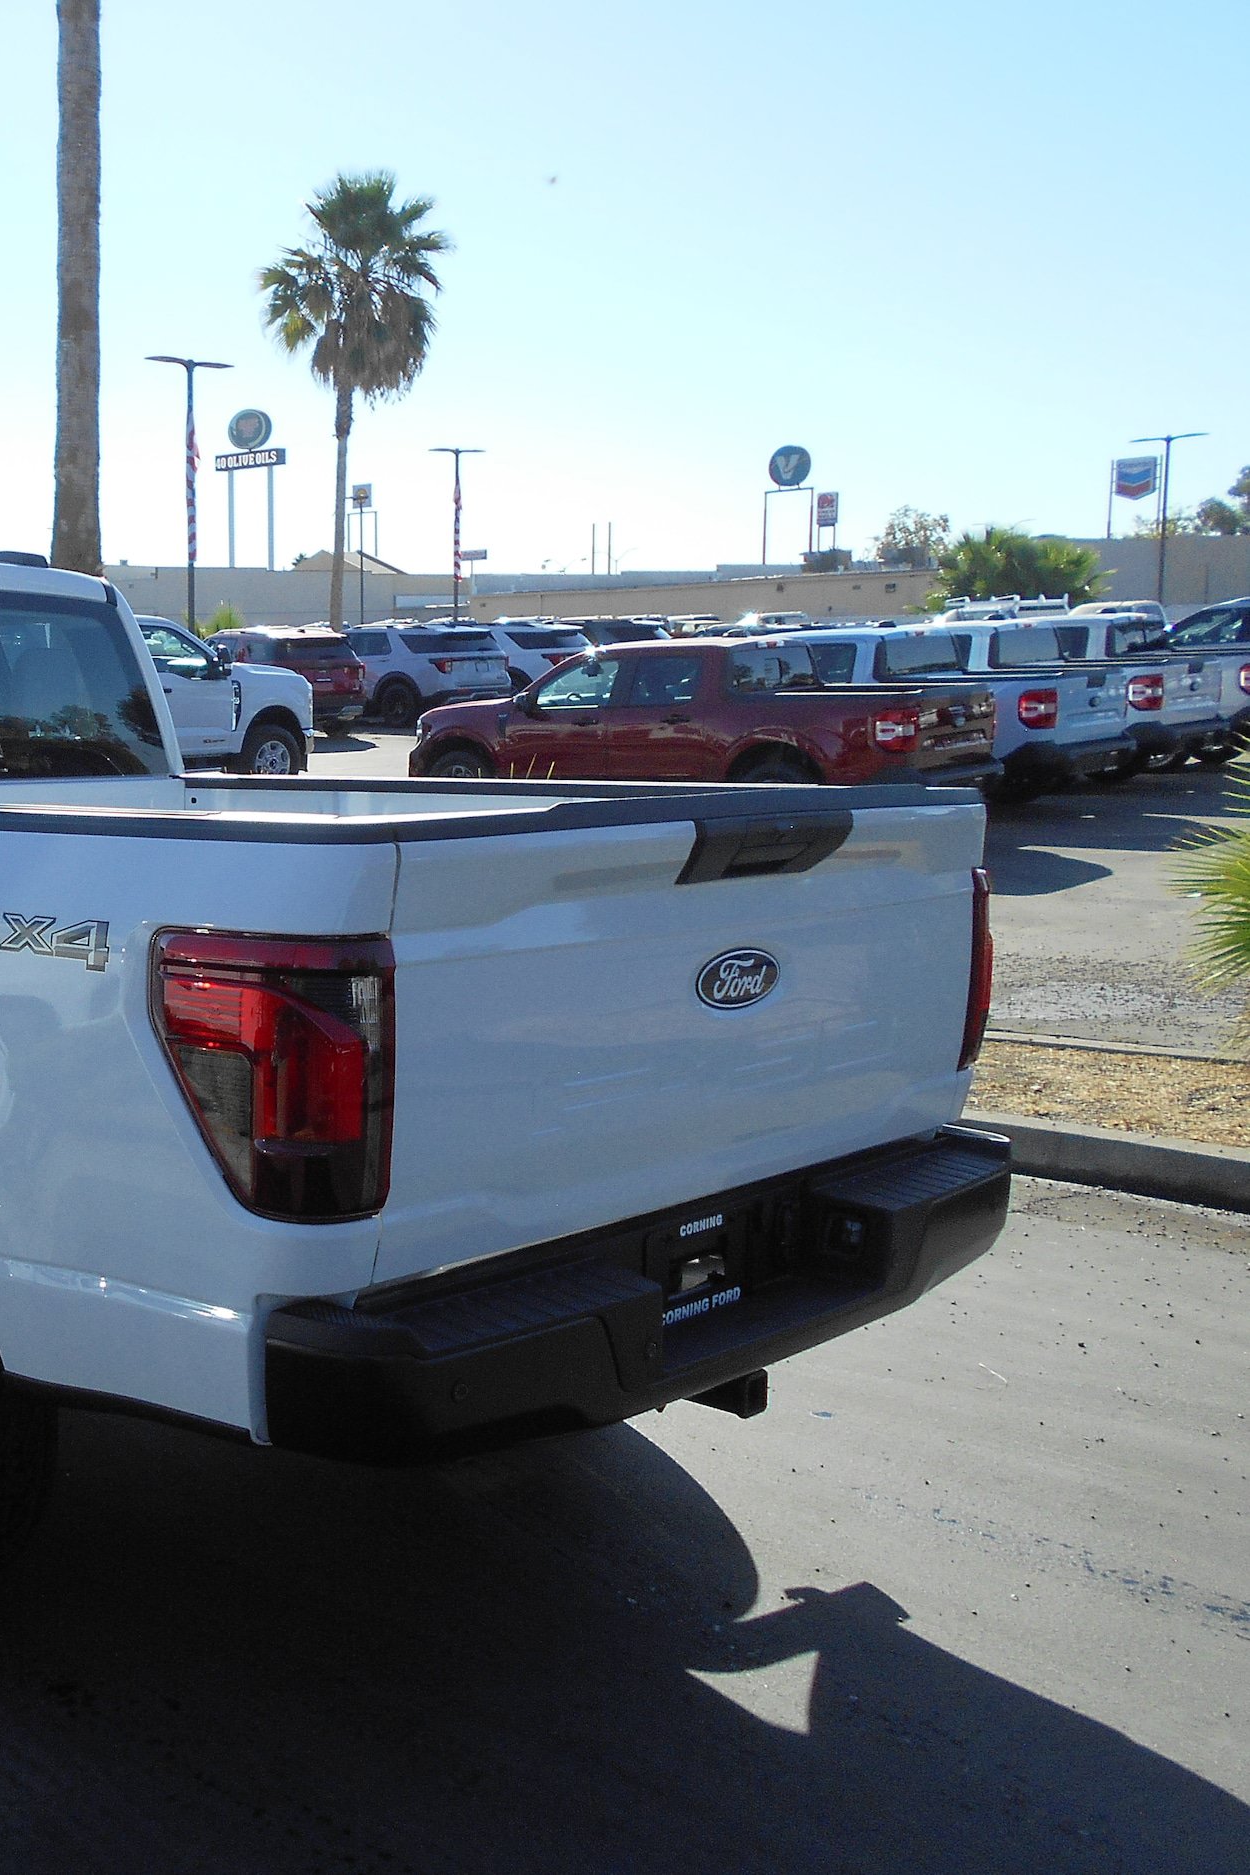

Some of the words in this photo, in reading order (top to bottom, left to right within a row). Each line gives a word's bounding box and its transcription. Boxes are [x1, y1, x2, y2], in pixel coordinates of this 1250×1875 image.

[227, 453, 255, 468] OLIVE
[255, 450, 277, 465] OILS
[713, 958, 767, 1000] Ford
[679, 1214, 723, 1237] CORNING
[712, 1286, 741, 1308] FORD
